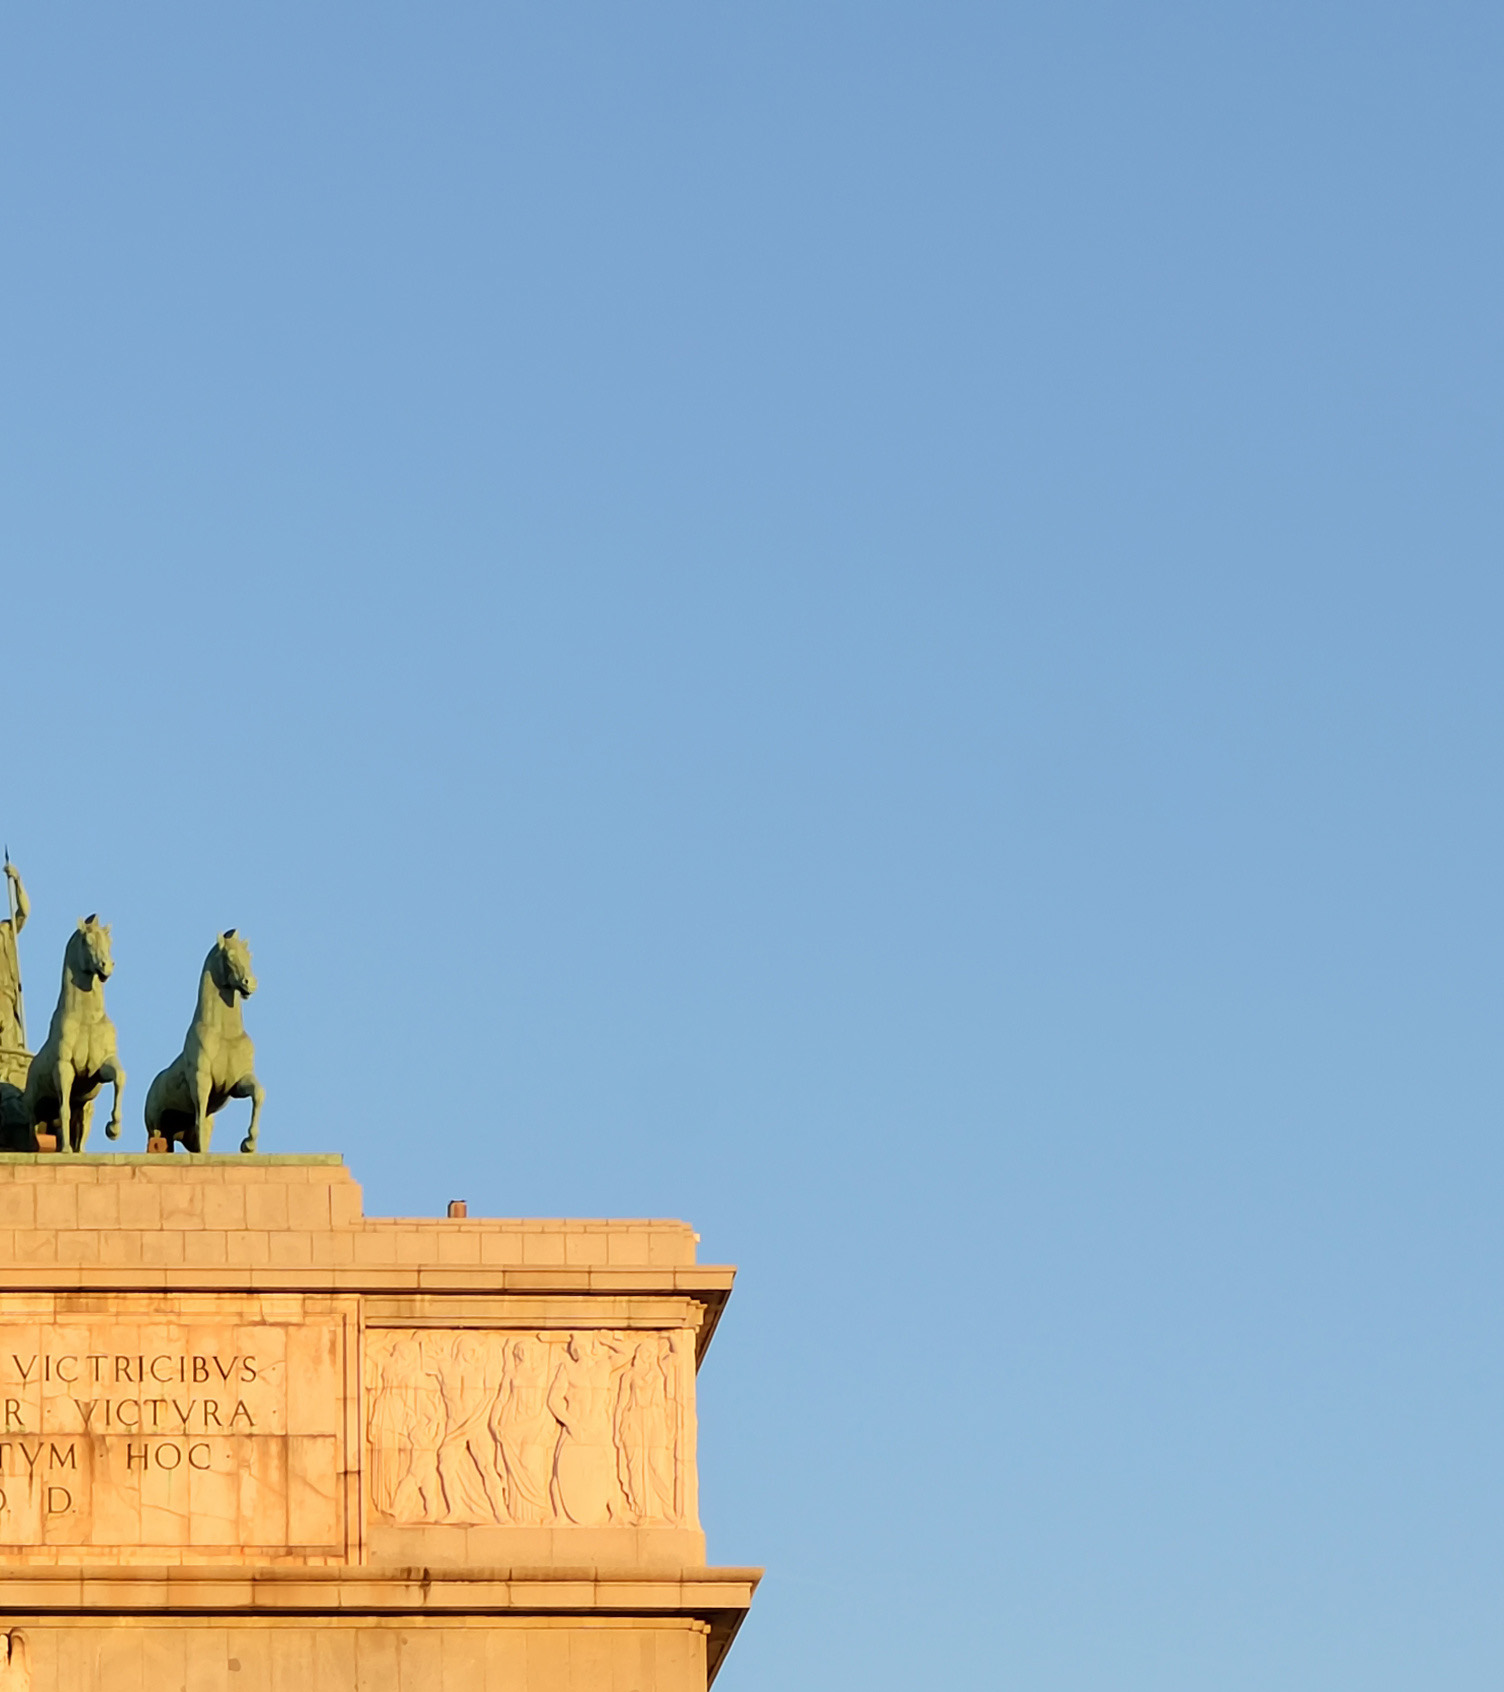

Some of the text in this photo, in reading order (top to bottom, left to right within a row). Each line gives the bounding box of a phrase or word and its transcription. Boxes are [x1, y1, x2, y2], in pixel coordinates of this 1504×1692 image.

[12, 1354, 257, 1384] VICTRICIBVS
[74, 1398, 257, 1428] VICTVRA
[126, 1443, 212, 1471] HOC
